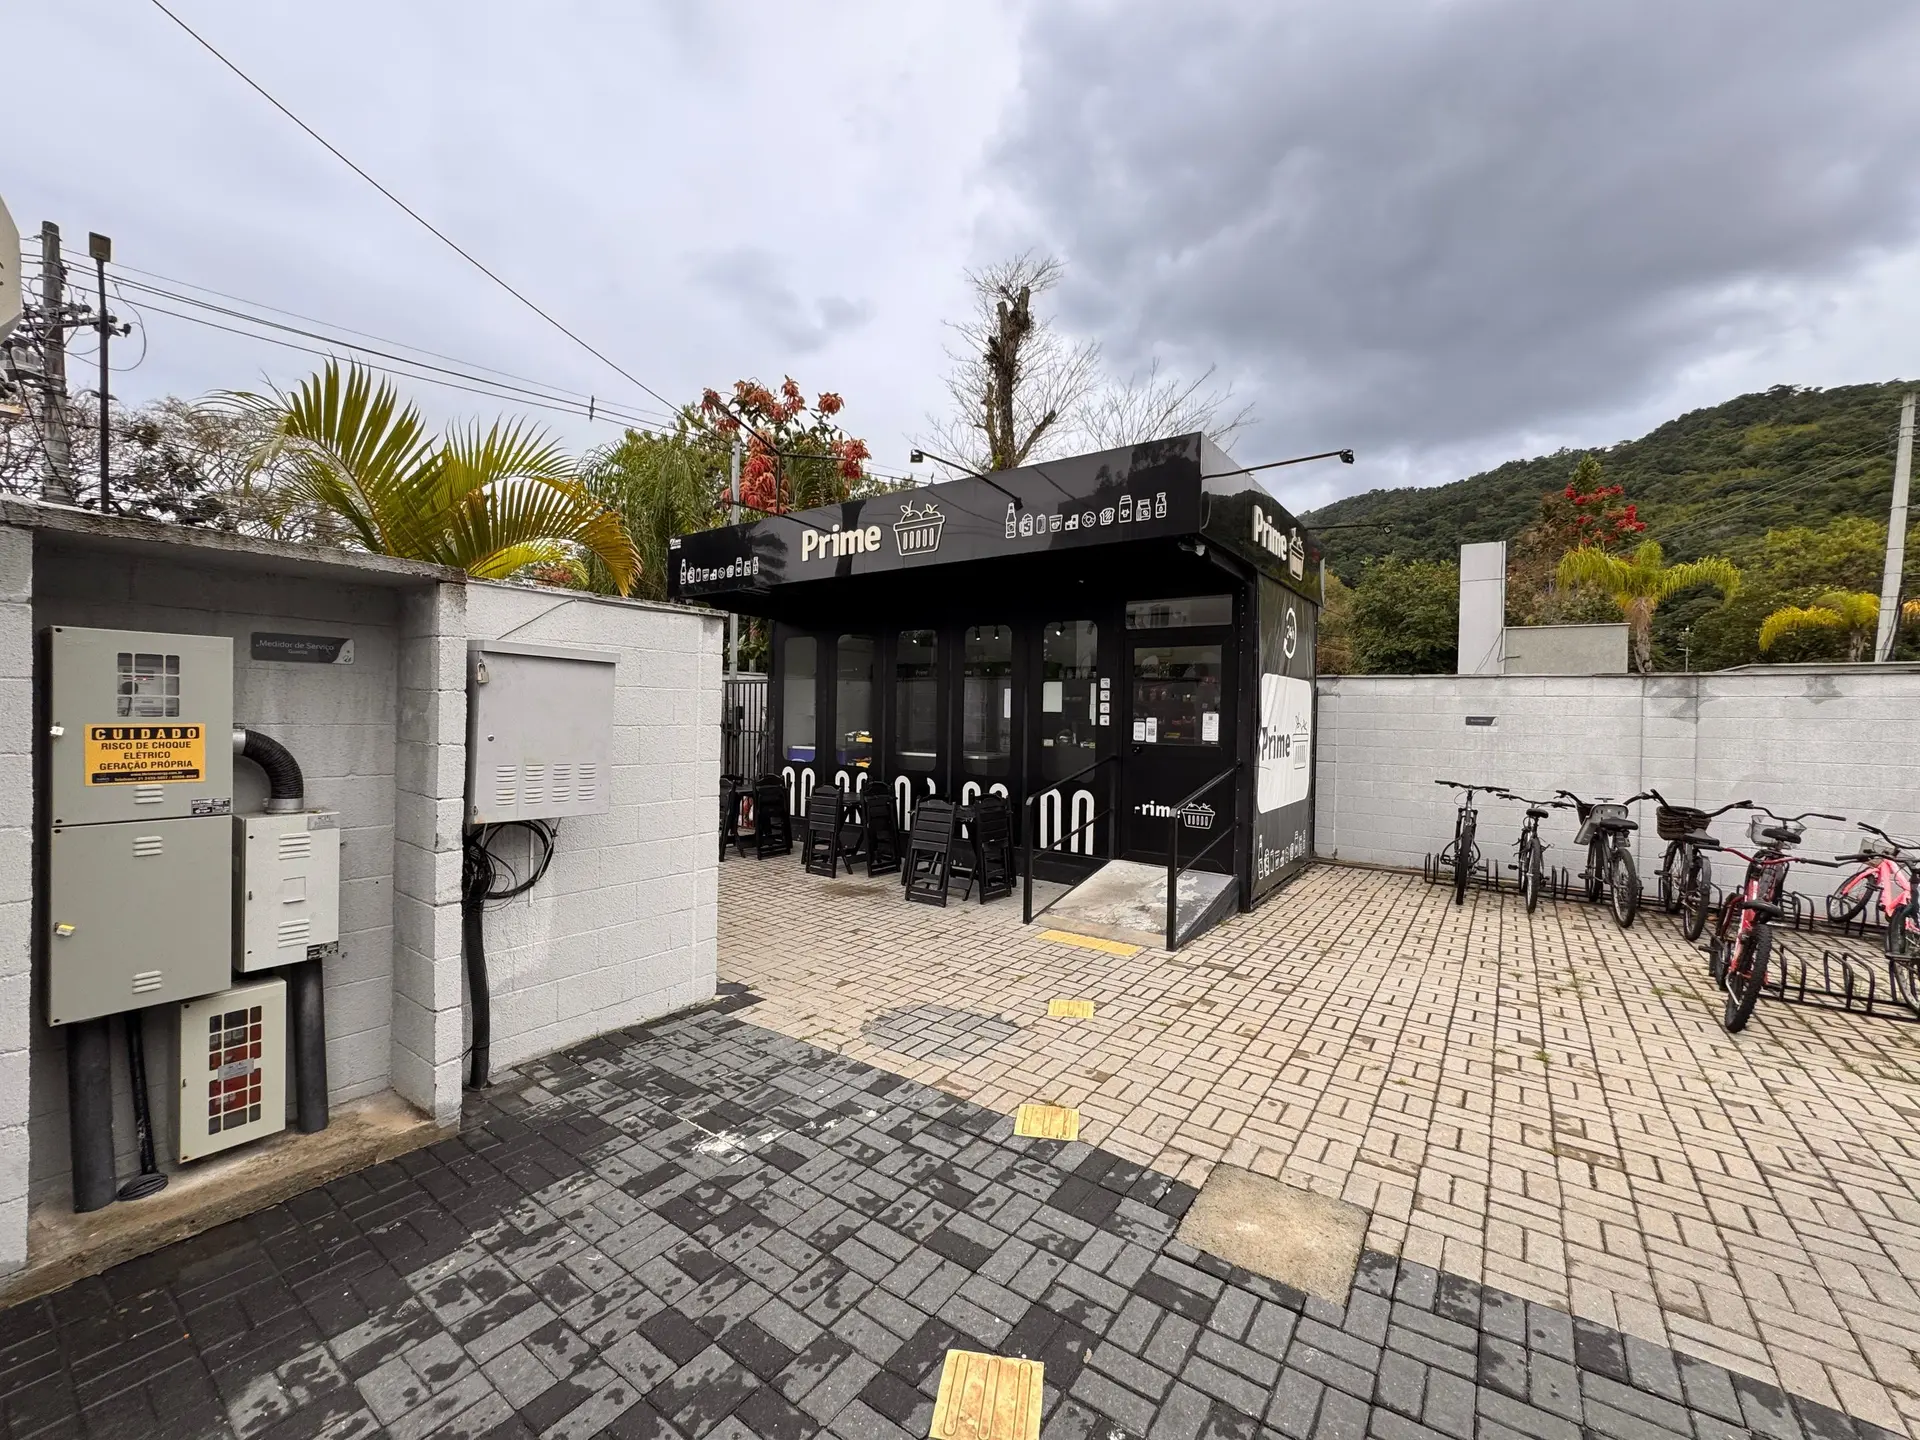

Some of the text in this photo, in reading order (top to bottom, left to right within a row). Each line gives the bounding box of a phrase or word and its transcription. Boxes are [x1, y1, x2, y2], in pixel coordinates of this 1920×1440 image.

[1252, 504, 1288, 561] Prime
[801, 524, 882, 562] Prime
[259, 639, 335, 651] Medidor de Serviço
[95, 728, 197, 740] CUIDADO
[101, 742, 133, 750] RISCO
[152, 741, 191, 749] CHOQUE
[1261, 725, 1291, 761] Prime
[124, 751, 170, 760] ELÉTRICO
[99, 760, 193, 771] GERAÇÃO PRÓPRIA
[1134, 800, 1181, 818] rim
